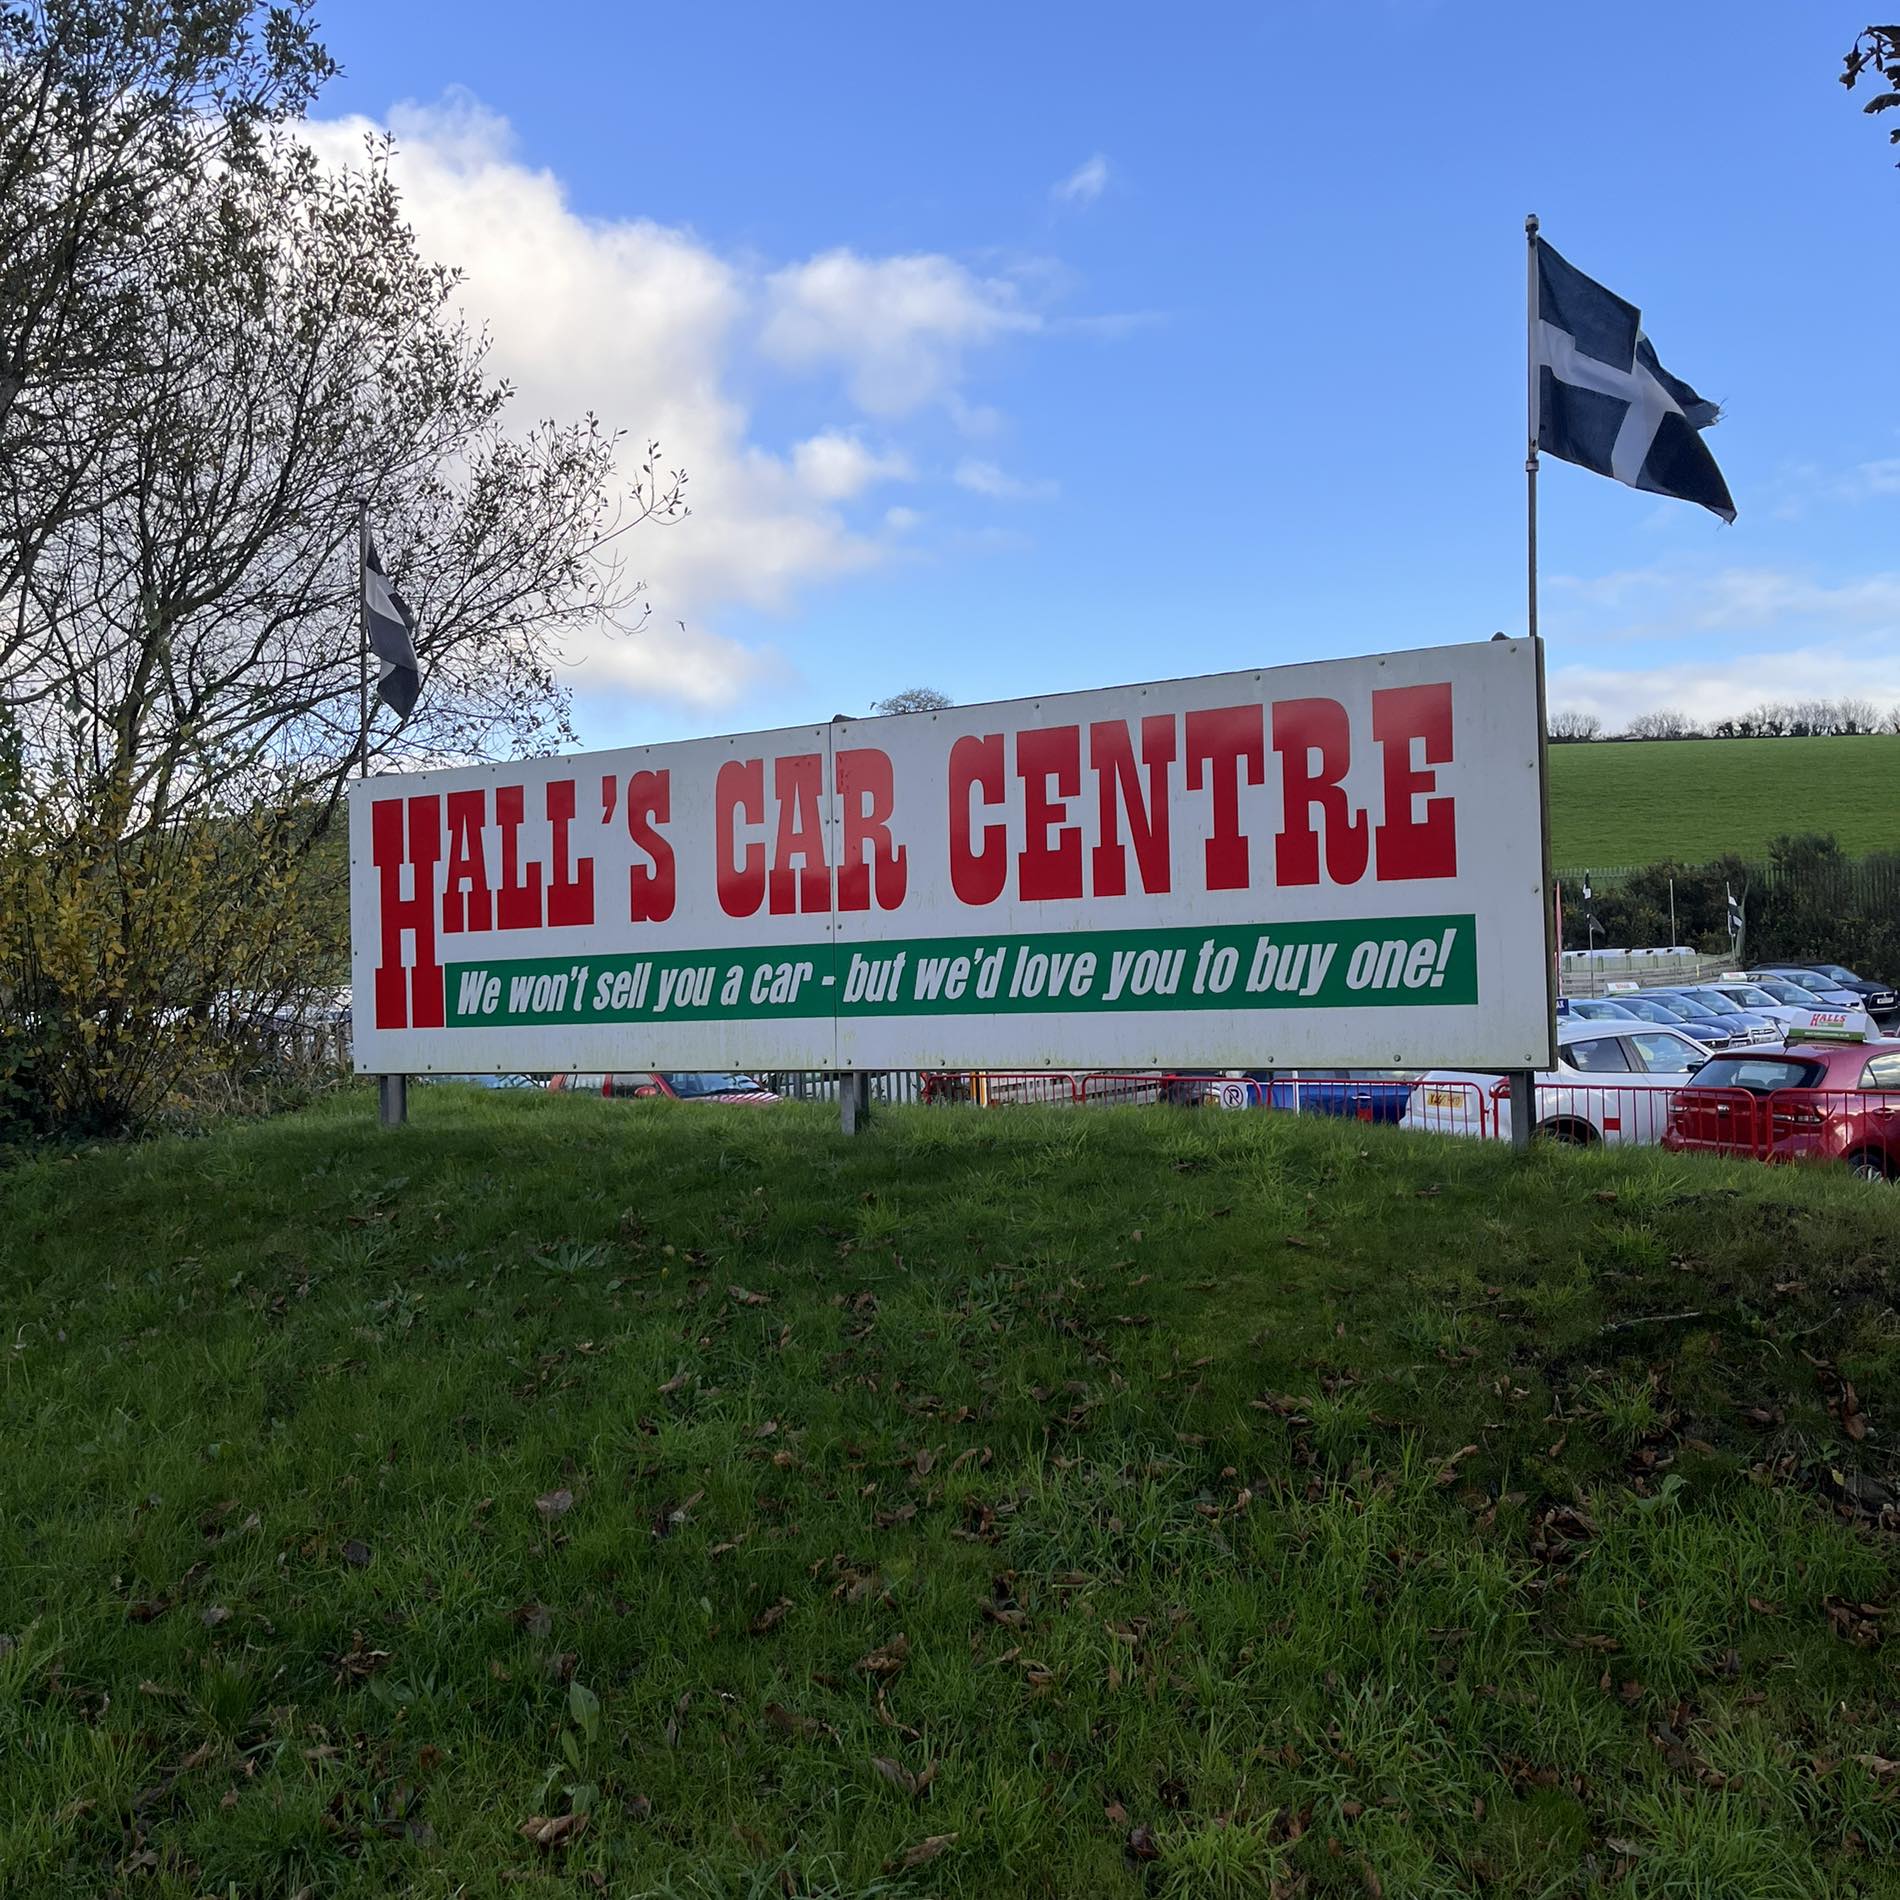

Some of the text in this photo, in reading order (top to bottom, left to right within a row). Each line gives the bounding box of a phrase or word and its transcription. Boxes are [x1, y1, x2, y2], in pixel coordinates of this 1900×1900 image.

[371, 684, 1457, 1030] HALL'S CAR CENTRE
[457, 928, 1457, 1015] We won't sell you a car - but we'd love you to buy one!
